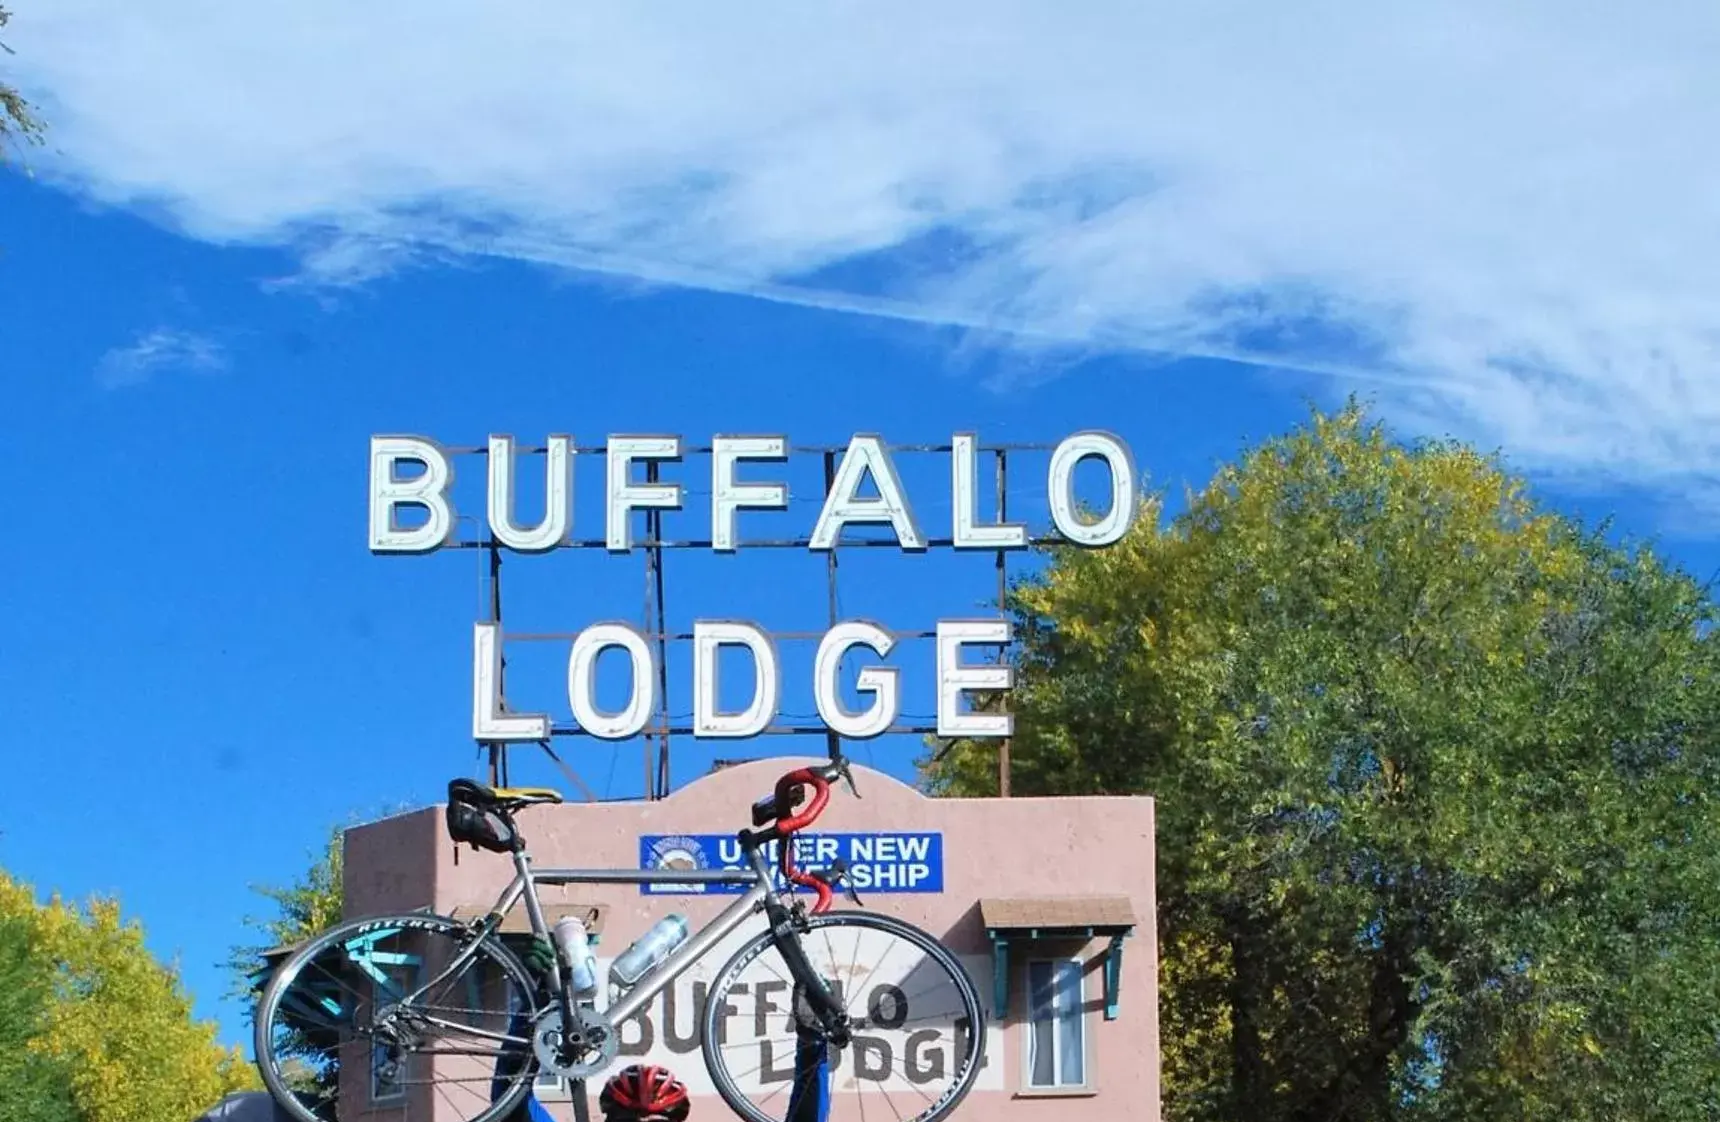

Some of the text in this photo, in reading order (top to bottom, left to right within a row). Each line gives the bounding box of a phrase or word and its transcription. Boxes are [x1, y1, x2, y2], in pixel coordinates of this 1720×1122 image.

[368, 430, 1139, 553] BUFFALO
[472, 619, 1014, 740] LODGE
[851, 837, 930, 862] NEW
